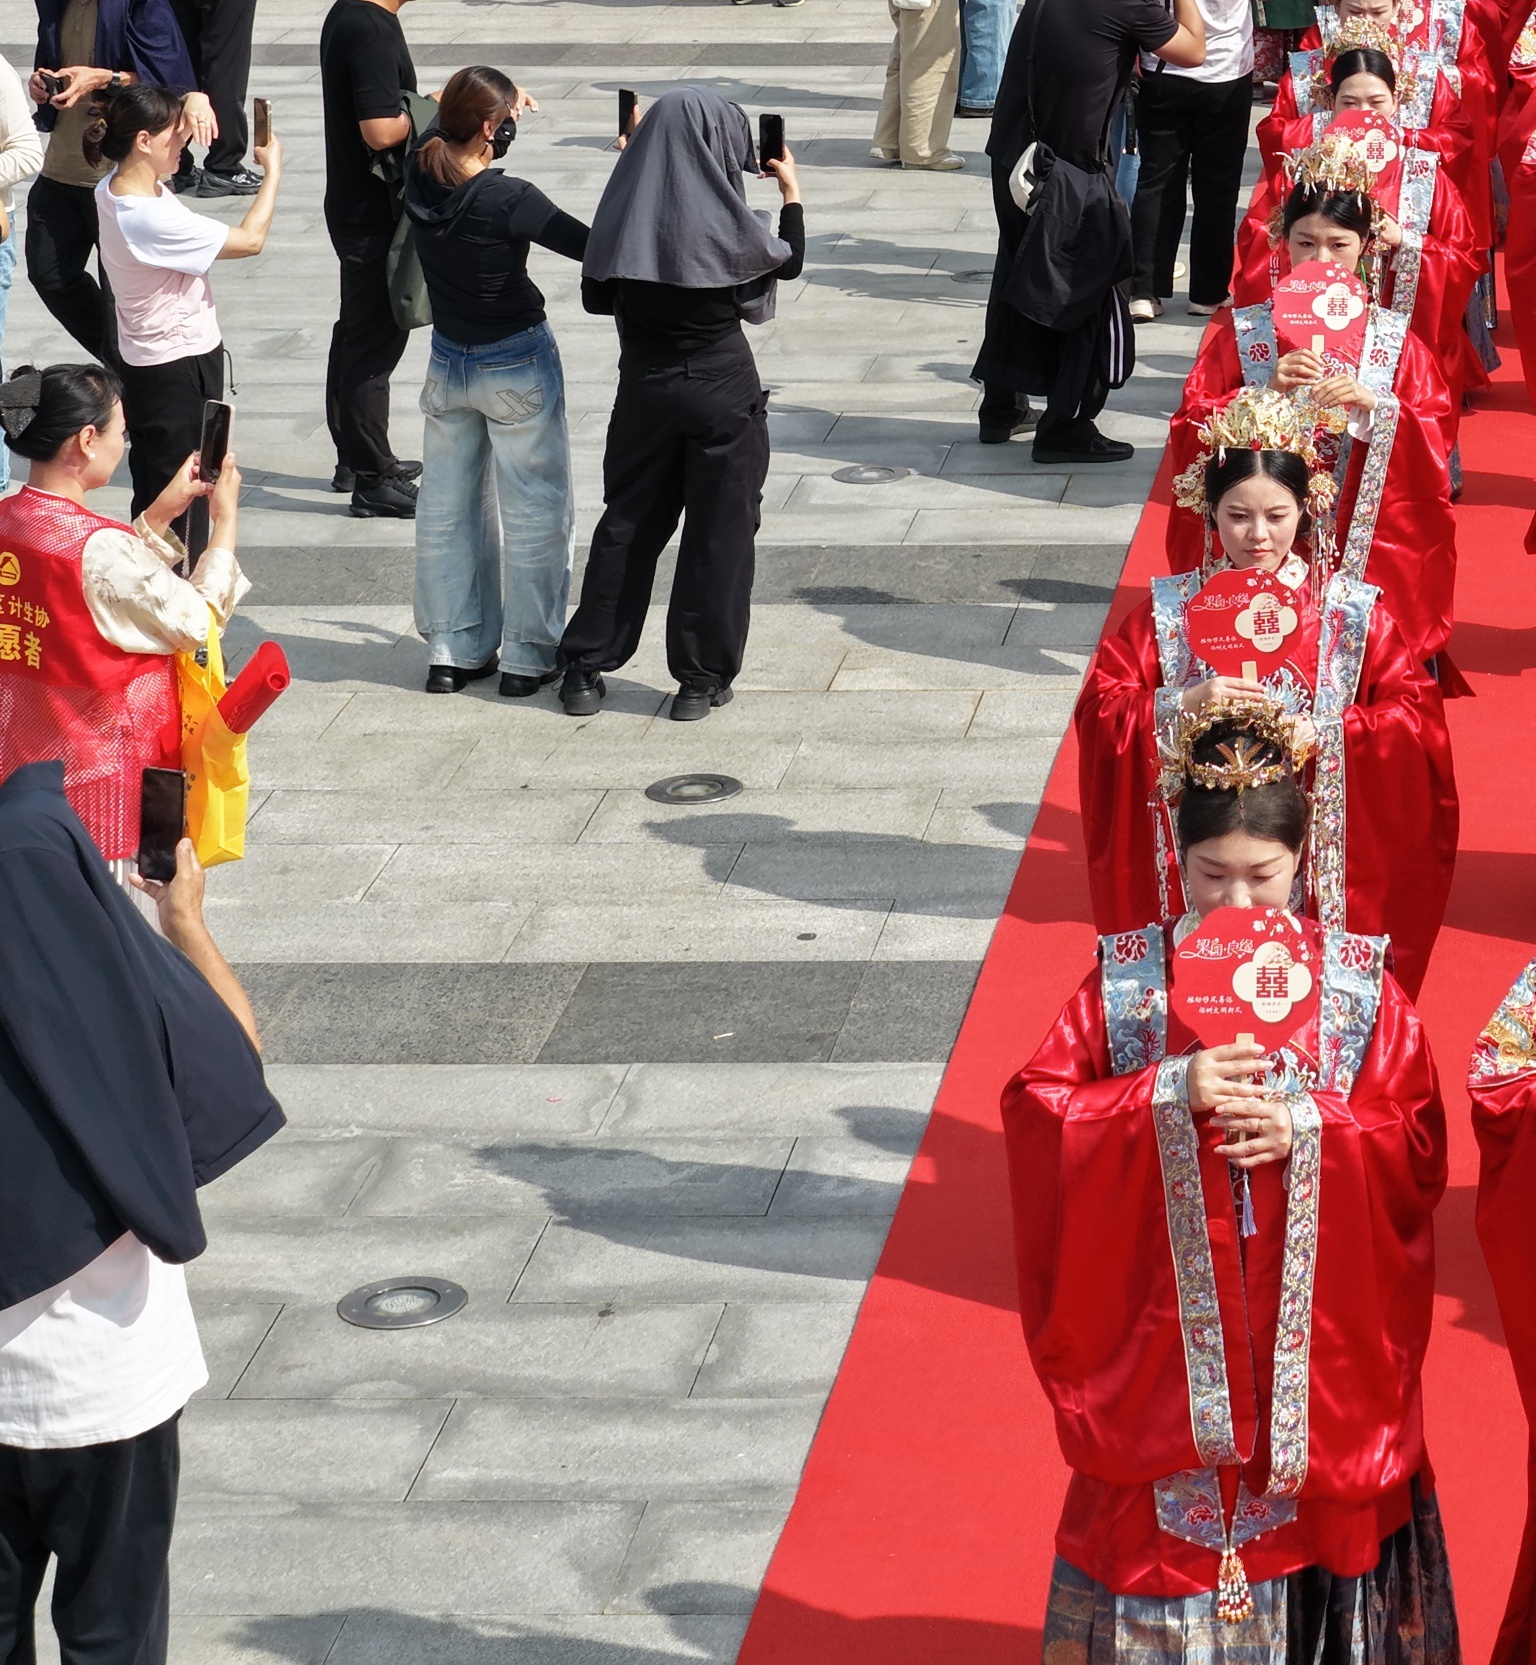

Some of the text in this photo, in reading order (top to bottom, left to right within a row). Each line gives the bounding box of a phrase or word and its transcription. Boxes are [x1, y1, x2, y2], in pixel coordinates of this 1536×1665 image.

[8, 595, 51, 629] 计生协
[1255, 965, 1289, 999] 囍
